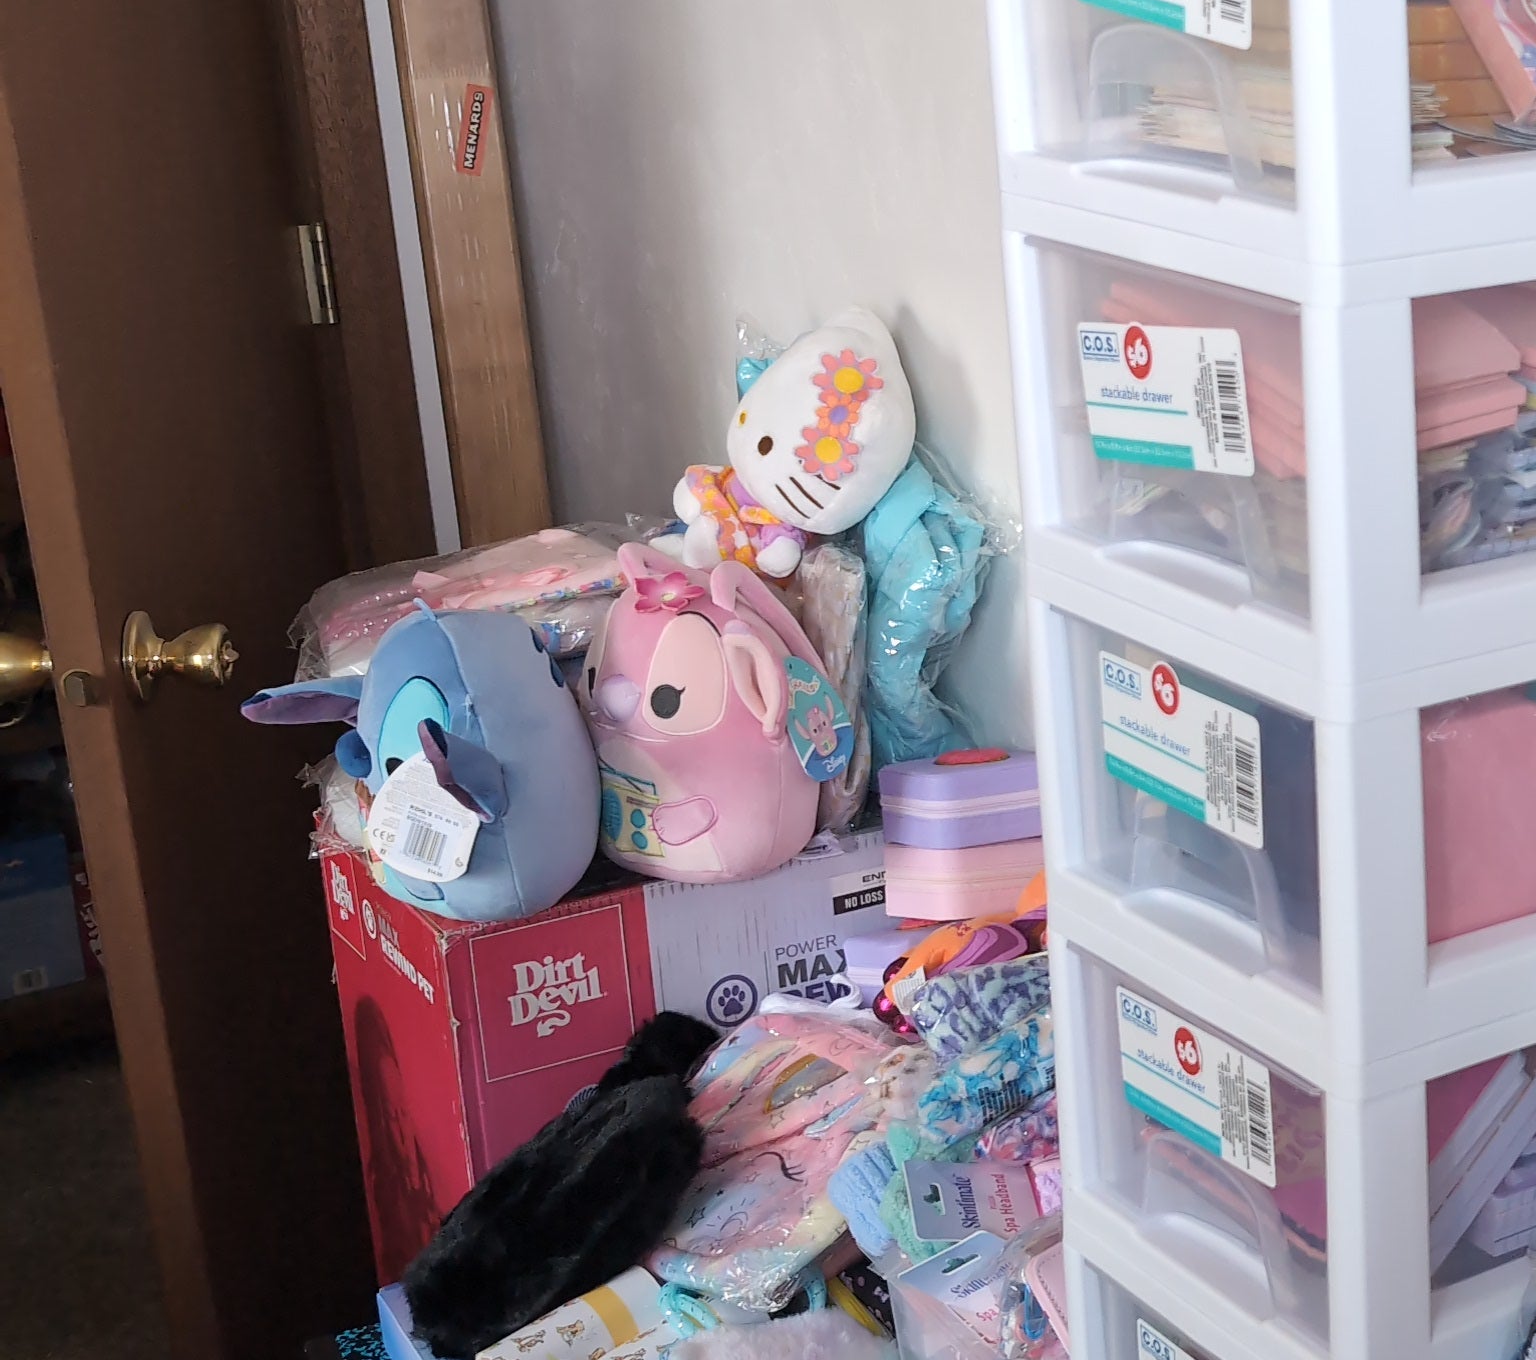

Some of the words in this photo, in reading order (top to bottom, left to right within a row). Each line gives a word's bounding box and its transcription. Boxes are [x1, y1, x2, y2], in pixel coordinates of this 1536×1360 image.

[463, 92, 485, 169] MENARDS
[1083, 335, 1117, 353] C.O.S.
[1127, 337, 1149, 368] $6
[1101, 385, 1140, 400] stackable
[1142, 388, 1173, 404] drawer
[1105, 663, 1140, 690] C.O.S.
[1153, 672, 1175, 707] $6
[1119, 715, 1159, 741] stackable
[1161, 733, 1190, 756] drawer
[844, 897, 858, 910] NO
[860, 890, 884, 905] LOSS
[775, 934, 837, 961] POWER
[513, 952, 585, 994] Dirt
[778, 948, 847, 988] MAX
[417, 971, 435, 1005] PET
[507, 966, 604, 1027] Devil
[1123, 998, 1155, 1027] C.O.S.
[1177, 1039, 1198, 1066] $6
[1137, 1048, 1175, 1077] stackable
[1177, 1070, 1206, 1094] drawer
[955, 1174, 980, 1229] Skintimate
[990, 1173, 1015, 1216] Headband
[1003, 1217, 1021, 1233] Spa
[976, 1307, 998, 1322] Spa
